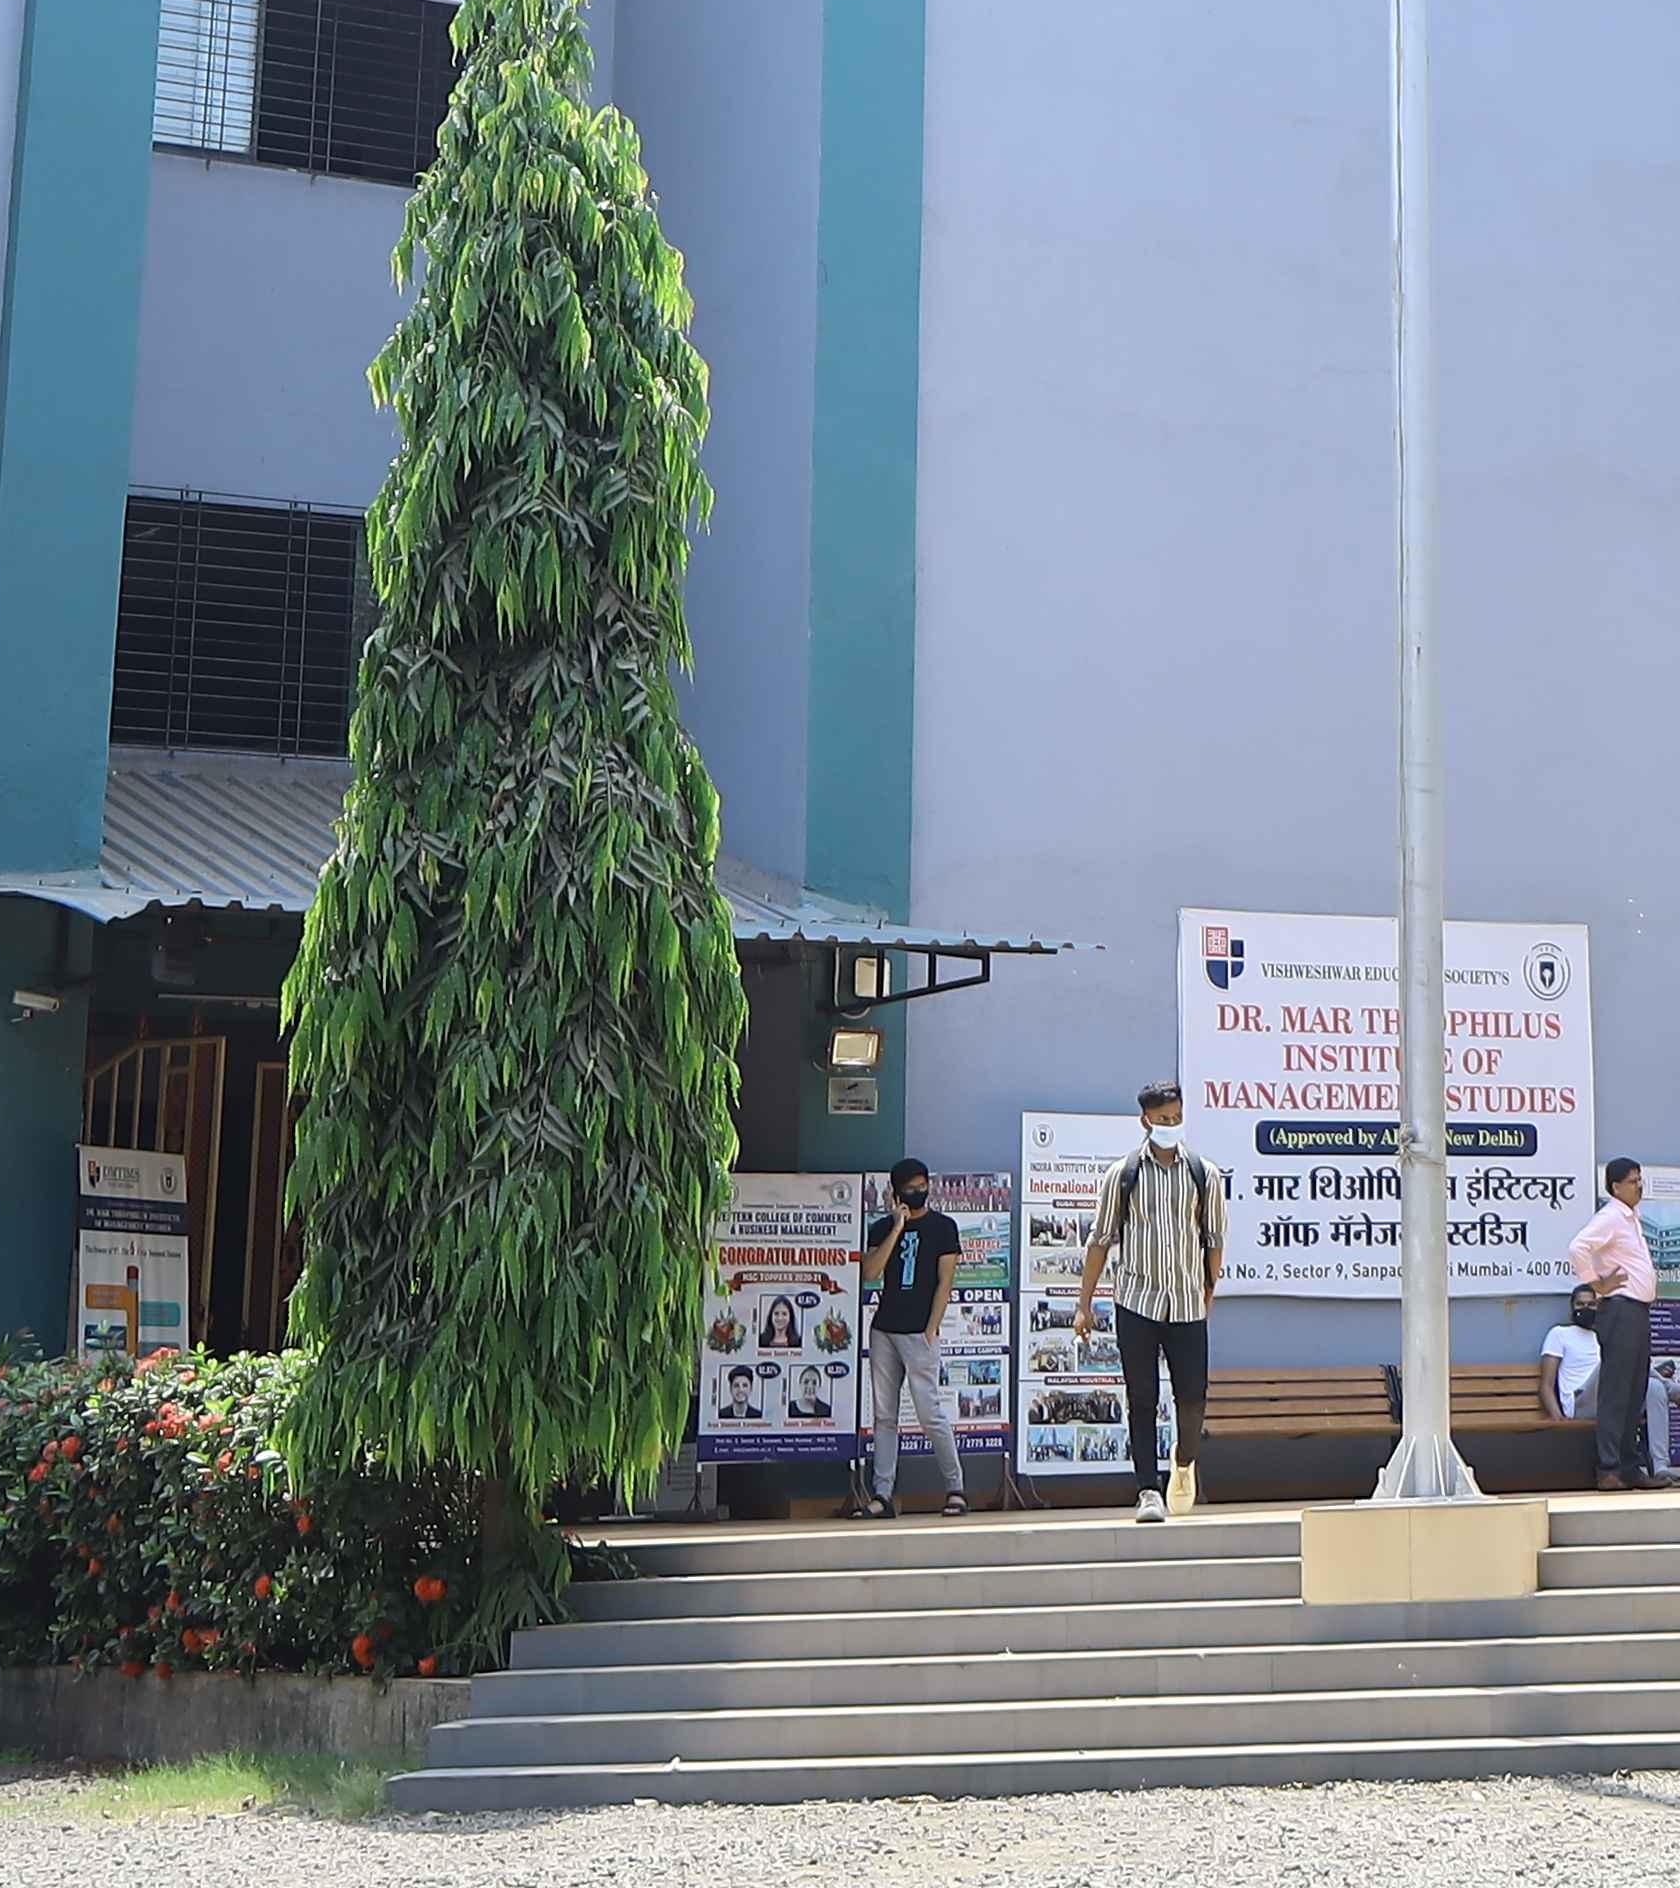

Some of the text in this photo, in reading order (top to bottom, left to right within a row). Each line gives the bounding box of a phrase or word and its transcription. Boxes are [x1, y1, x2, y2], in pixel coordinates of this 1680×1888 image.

[1261, 962, 1361, 982] VISHWESHWAR
[1444, 969, 1510, 986] SOCIETY'S
[1217, 1004, 1562, 1039] DR. MAR THPHILUS
[1462, 1048, 1503, 1075] OF
[1205, 1080, 1576, 1113] MANAGEME STUDIES
[1269, 1127, 1354, 1148] (Approved
[1358, 1127, 1377, 1148] by
[1479, 1128, 1525, 1148] Delhi)
[1029, 1177, 1097, 1194] International
[1254, 1176, 1299, 1201] मार
[756, 1212, 790, 1223] COLLEGE
[739, 1224, 778, 1235] BUSINESS
[781, 1225, 838, 1236] MANAGEMENT
[1257, 1215, 1319, 1248] ऑफ
[719, 1247, 848, 1266] CONGRATULATIONS
[1236, 1264, 1261, 1280] No.
[1265, 1264, 1278, 1282] 2,
[1282, 1263, 1331, 1280] Sector
[1335, 1263, 1349, 1282] 9,
[1457, 1261, 1513, 1278] Mumbai
[1526, 1261, 1550, 1277] 400
[963, 1288, 1004, 1302] OPEN
